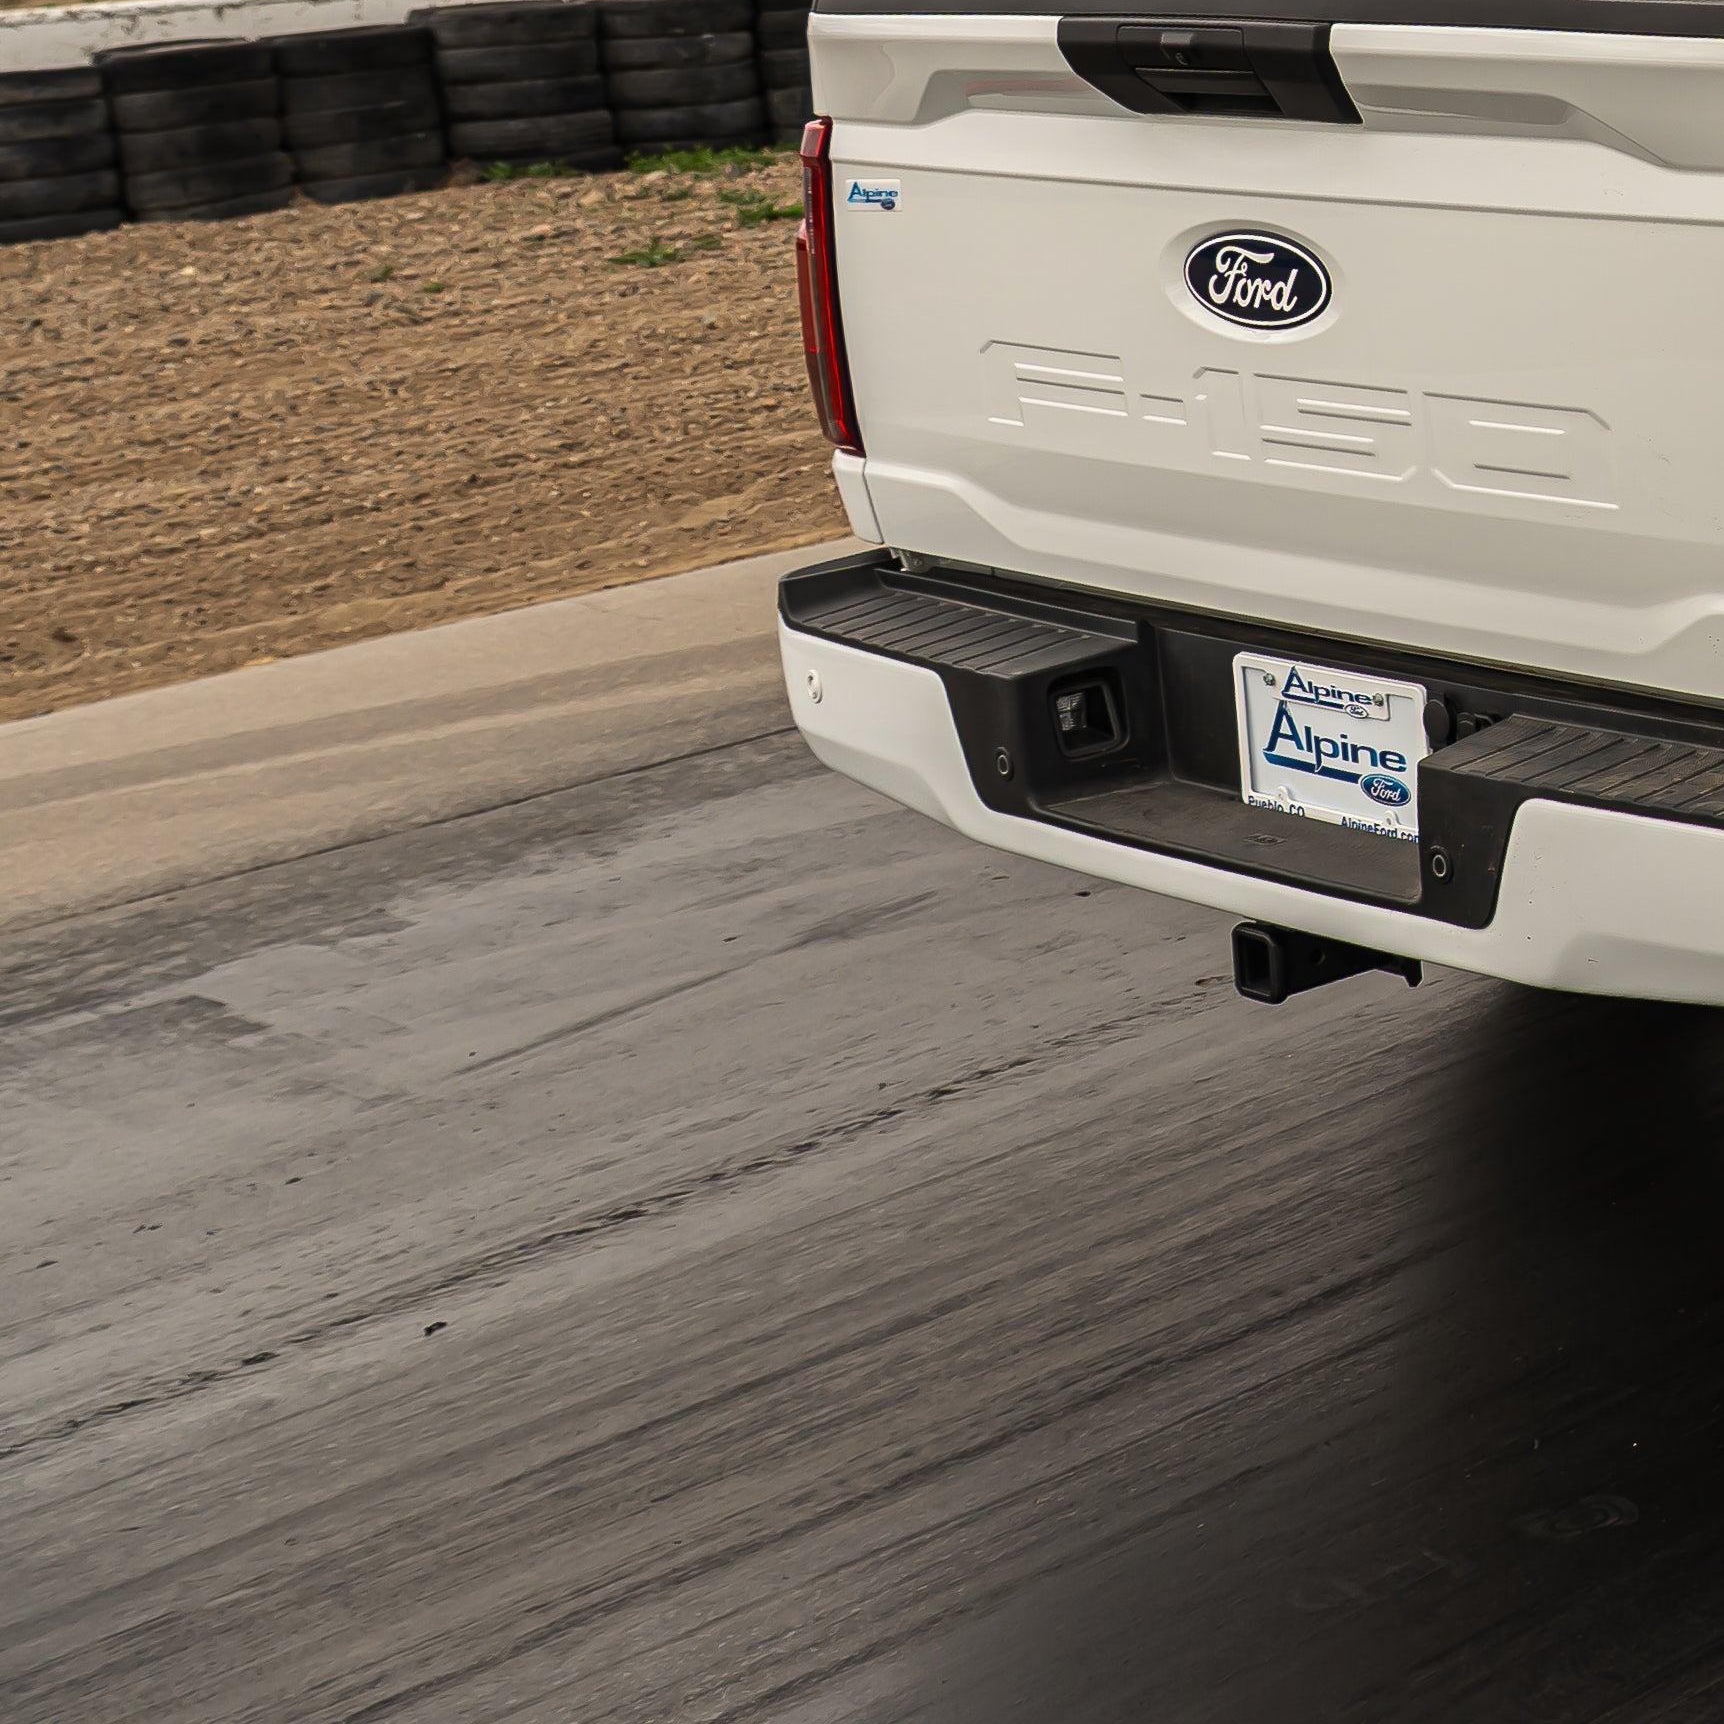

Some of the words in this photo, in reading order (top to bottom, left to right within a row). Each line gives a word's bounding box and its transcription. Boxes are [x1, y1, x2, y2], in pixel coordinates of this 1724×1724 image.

[1209, 243, 1299, 315] Ford
[978, 338, 1621, 511] F-150
[1281, 665, 1373, 705] Alpine
[1262, 700, 1408, 773] Alpine
[1289, 804, 1305, 817] CO
[1370, 778, 1402, 803] Ford
